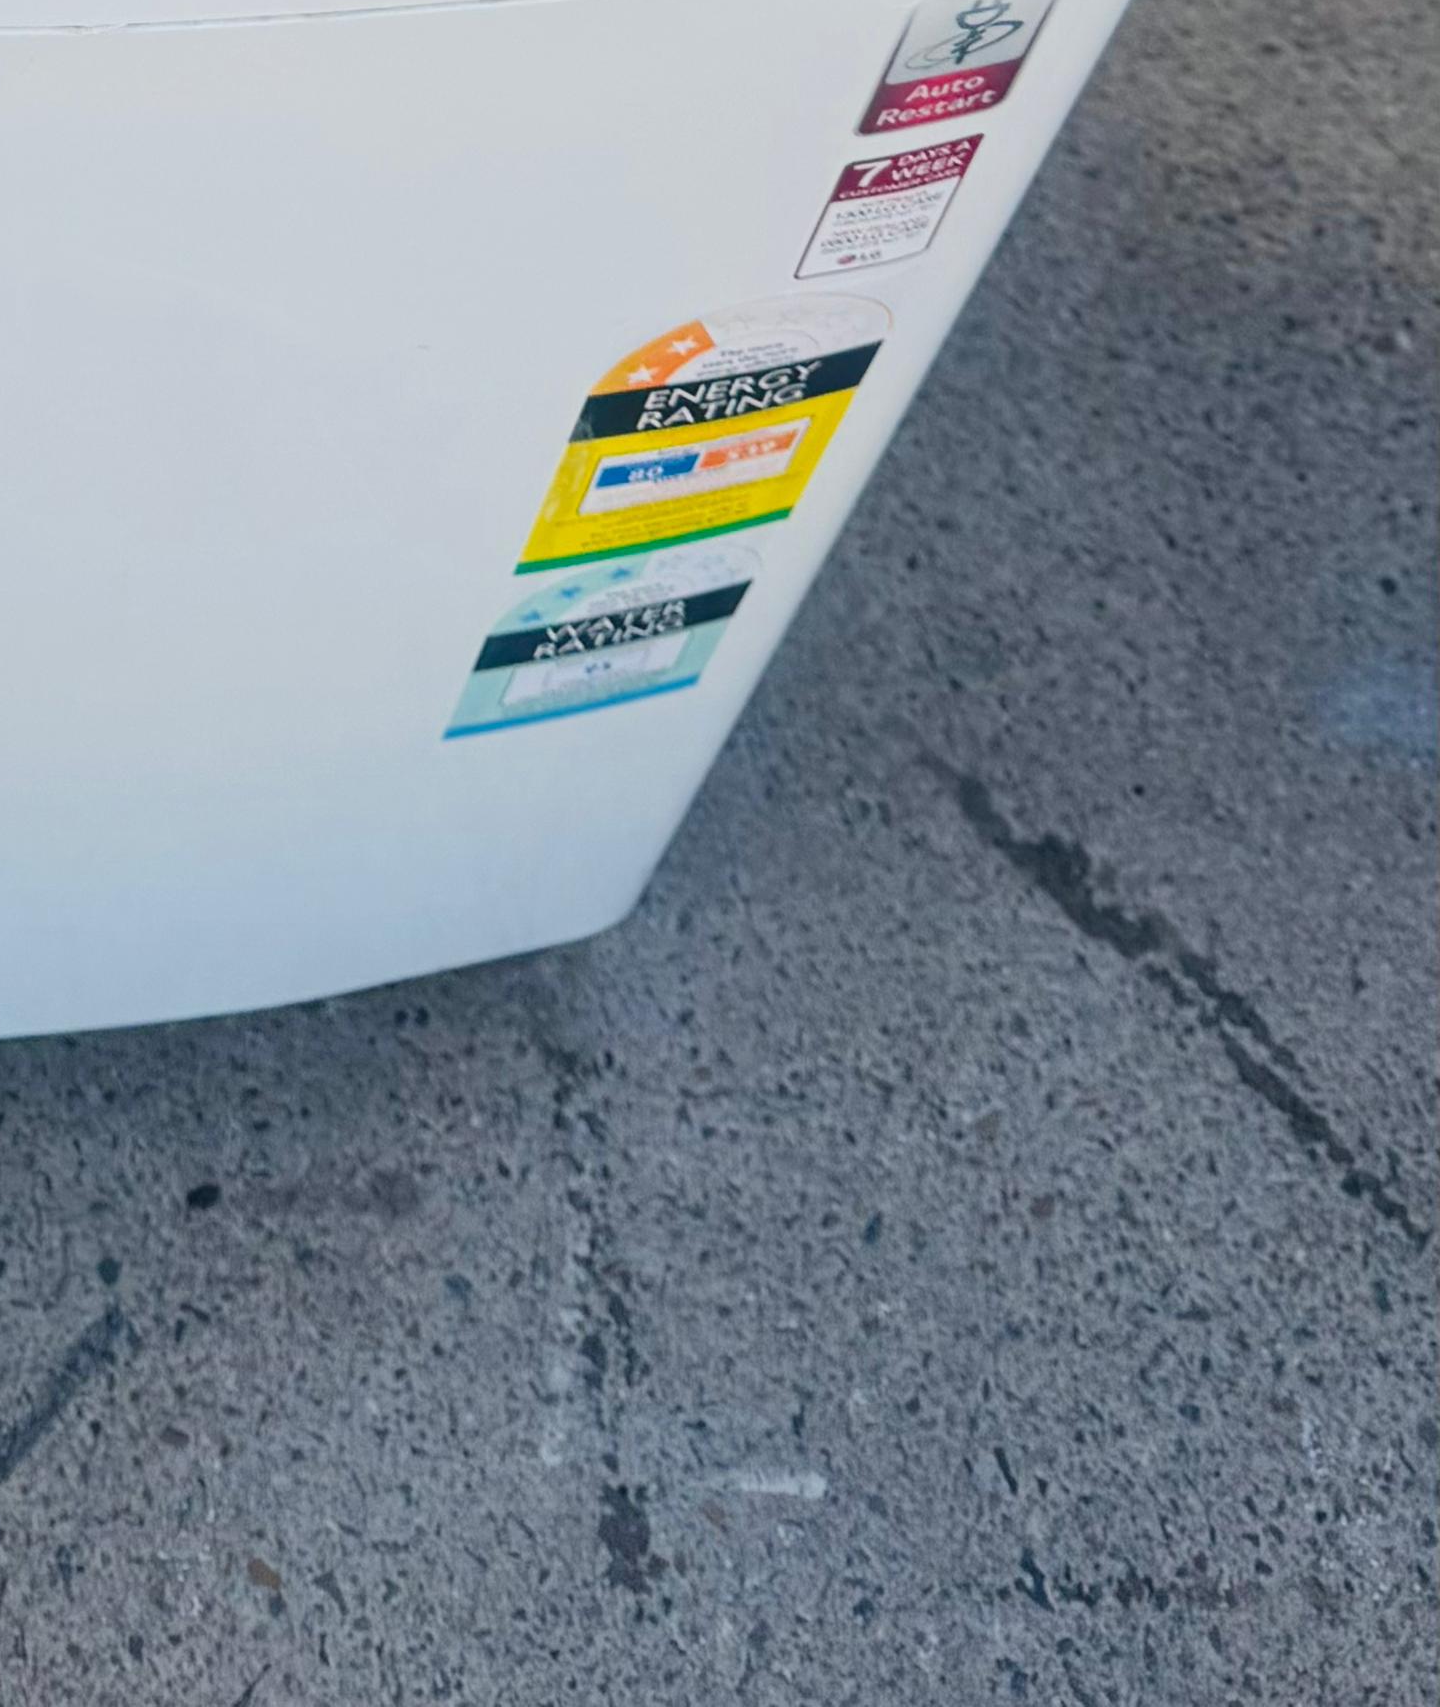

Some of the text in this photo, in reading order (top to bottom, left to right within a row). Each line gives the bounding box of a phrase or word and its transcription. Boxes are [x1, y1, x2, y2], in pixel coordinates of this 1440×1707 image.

[876, 89, 997, 127] Restart
[905, 76, 985, 103] Auto
[853, 159, 892, 187] 7
[891, 152, 965, 181] WEEK
[898, 143, 952, 167] DAYS
[643, 360, 823, 412] ENERGY
[636, 383, 809, 431] RATING
[533, 613, 684, 660] RATING
[546, 600, 686, 642] WATER
